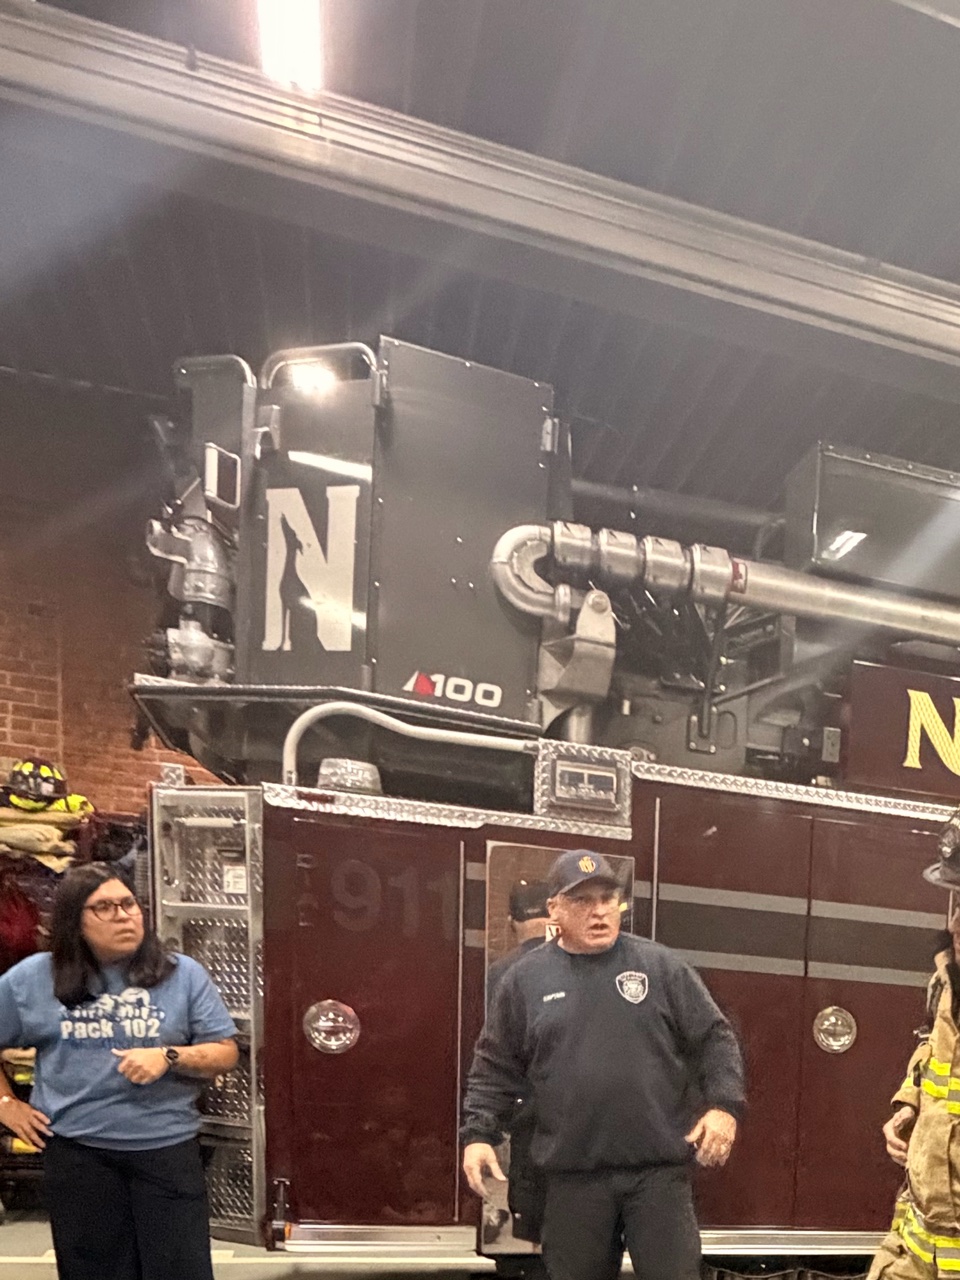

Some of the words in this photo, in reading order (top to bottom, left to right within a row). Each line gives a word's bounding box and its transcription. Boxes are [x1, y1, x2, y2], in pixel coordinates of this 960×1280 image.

[262, 485, 360, 652] N
[60, 1018, 115, 1040] Pack
[120, 1018, 161, 1039] 102
